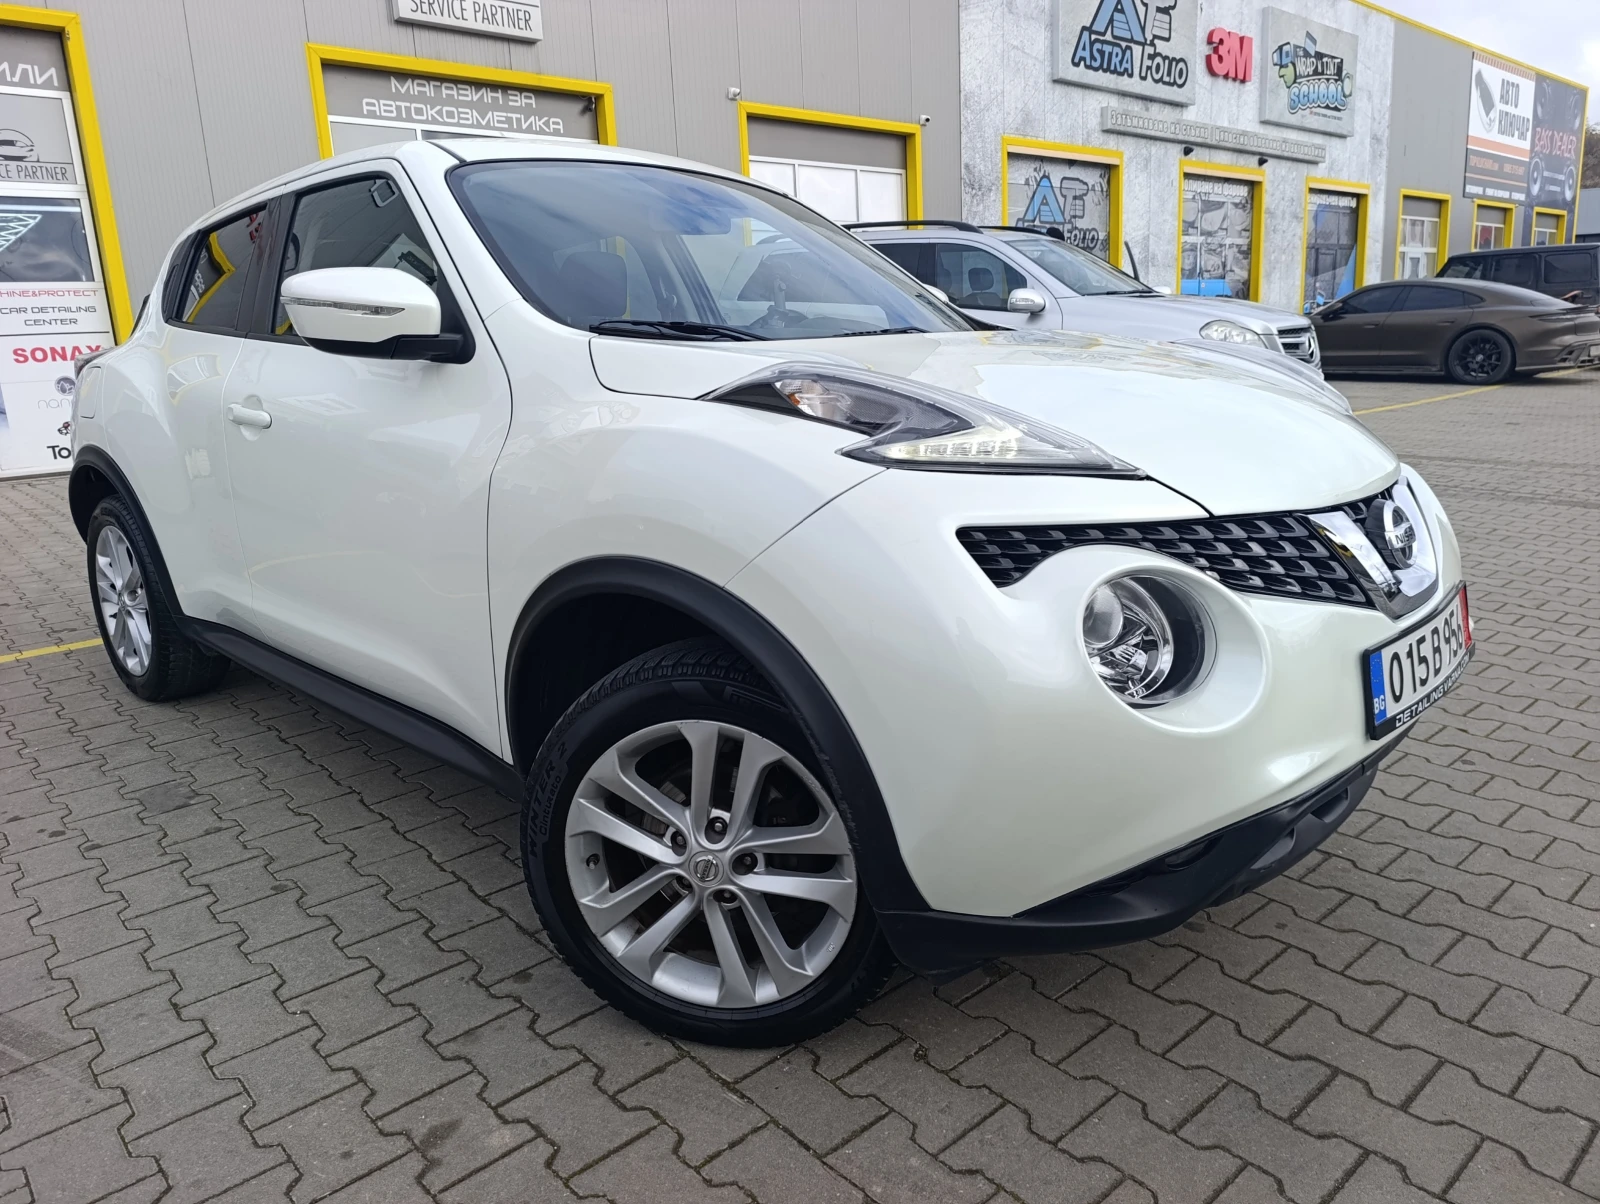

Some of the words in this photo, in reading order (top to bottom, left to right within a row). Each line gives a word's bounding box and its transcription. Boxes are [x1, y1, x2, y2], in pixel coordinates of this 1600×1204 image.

[411, 0, 468, 21] SERVICE
[473, 1, 533, 32] PARTNER
[1206, 27, 1253, 83] 3M
[1295, 57, 1316, 76] WRAP
[1322, 57, 1341, 75] TINT
[390, 75, 502, 105] МАГАЗИН
[508, 90, 536, 108] ЗА
[1288, 79, 1347, 113] SCHOOL
[1500, 78, 1520, 109] АВТО
[362, 98, 564, 134] АВТОКОЗМЕТИКА
[1497, 109, 1531, 142] КЛЮЧАР
[16, 164, 69, 181] PARTNER
[1183, 179, 1213, 194] олиране
[0, 307, 28, 315] CAR
[31, 305, 97, 314] DETAILING
[24, 318, 78, 326] CENTER
[1373, 695, 1385, 714] BG
[529, 759, 556, 859] WINTER
